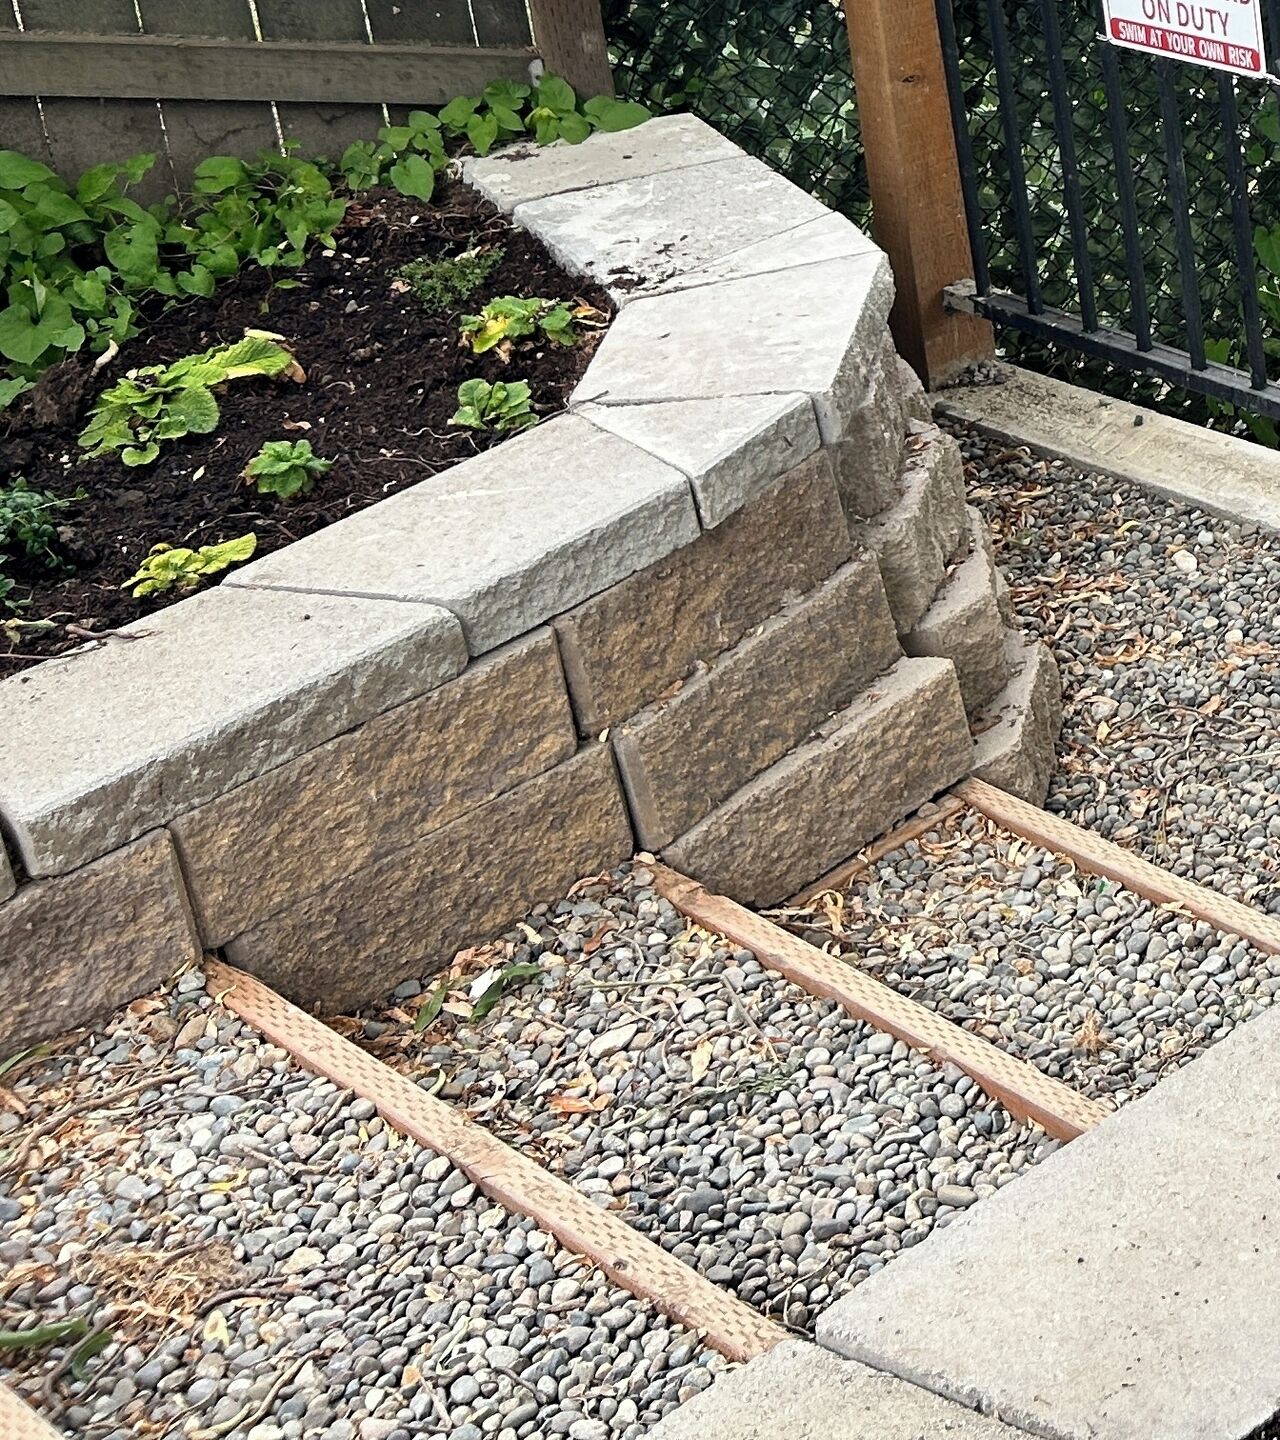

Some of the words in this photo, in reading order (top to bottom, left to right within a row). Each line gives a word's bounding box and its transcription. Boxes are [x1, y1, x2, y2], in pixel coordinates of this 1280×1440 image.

[1177, 2, 1229, 36] DUTY
[1119, 22, 1145, 43] SWIM
[1150, 29, 1163, 48] AT
[1166, 32, 1196, 56] YOUR
[1199, 40, 1225, 62] OWN
[1229, 46, 1254, 69] RISK
